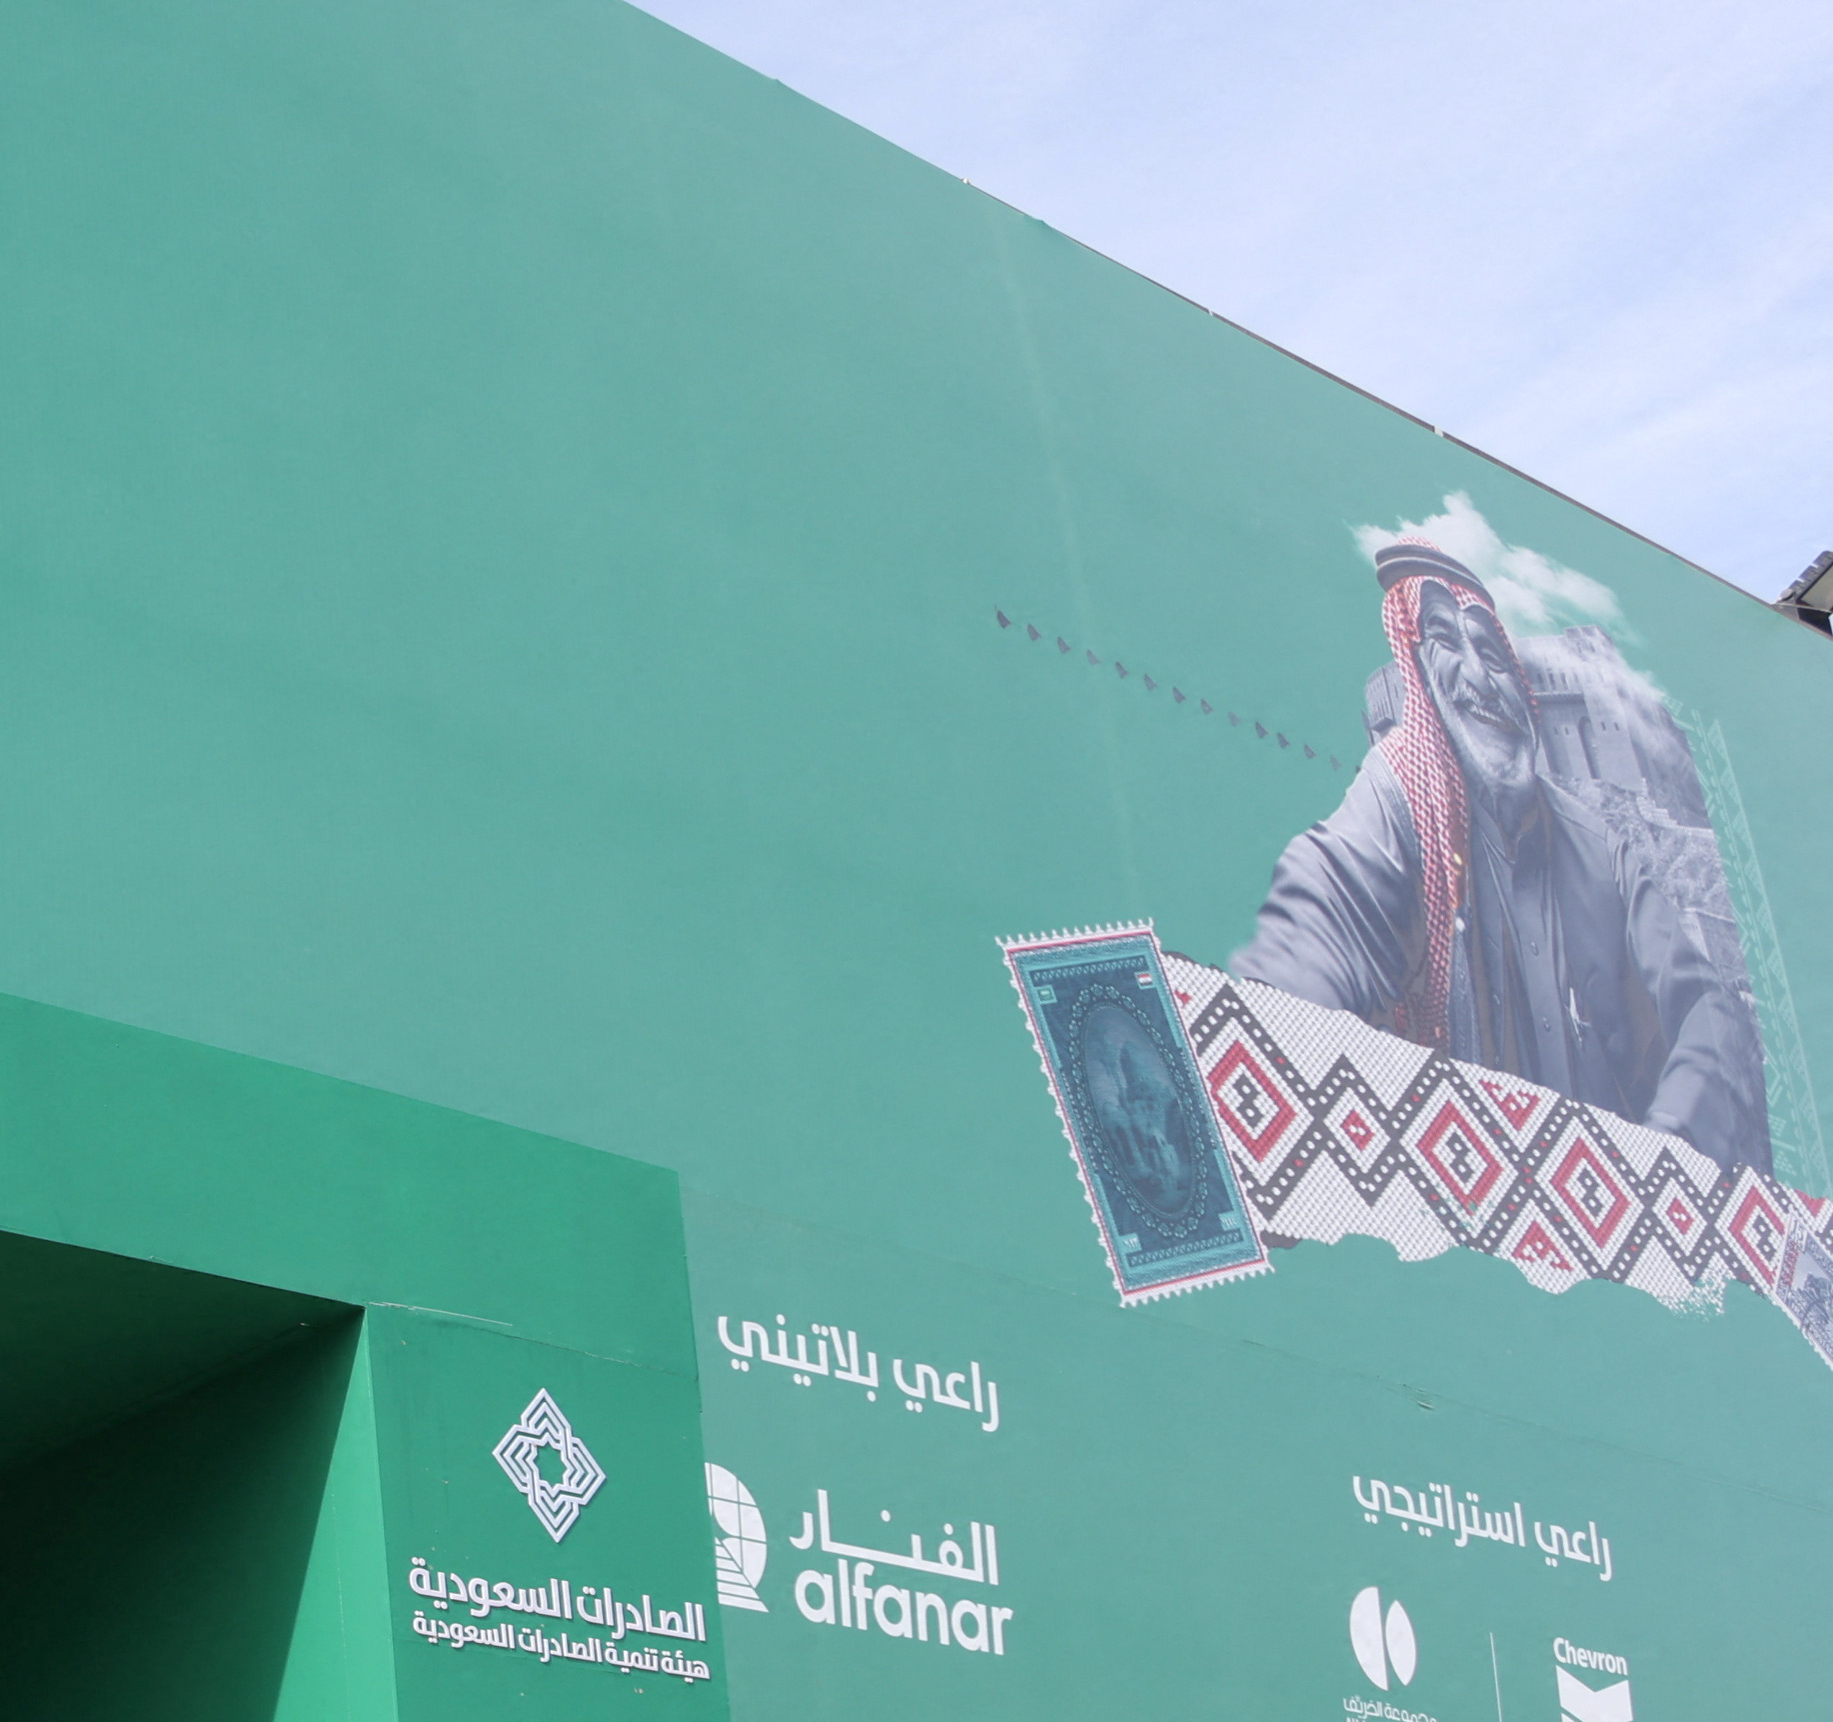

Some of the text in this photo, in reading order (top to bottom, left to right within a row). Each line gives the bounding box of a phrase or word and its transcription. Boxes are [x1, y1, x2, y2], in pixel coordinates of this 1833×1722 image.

[717, 1314, 999, 1432] راعي بلاتيني
[789, 1489, 999, 1586] الفنار
[1352, 1475, 1613, 1582] راعي استراتيجي
[409, 1556, 707, 1641] الصادرات السعودية
[413, 1611, 710, 1683] هيئة تنمية الصادرات السعودية
[794, 1559, 1014, 1656] alfanar
[1553, 1637, 1628, 1676] Chevron
